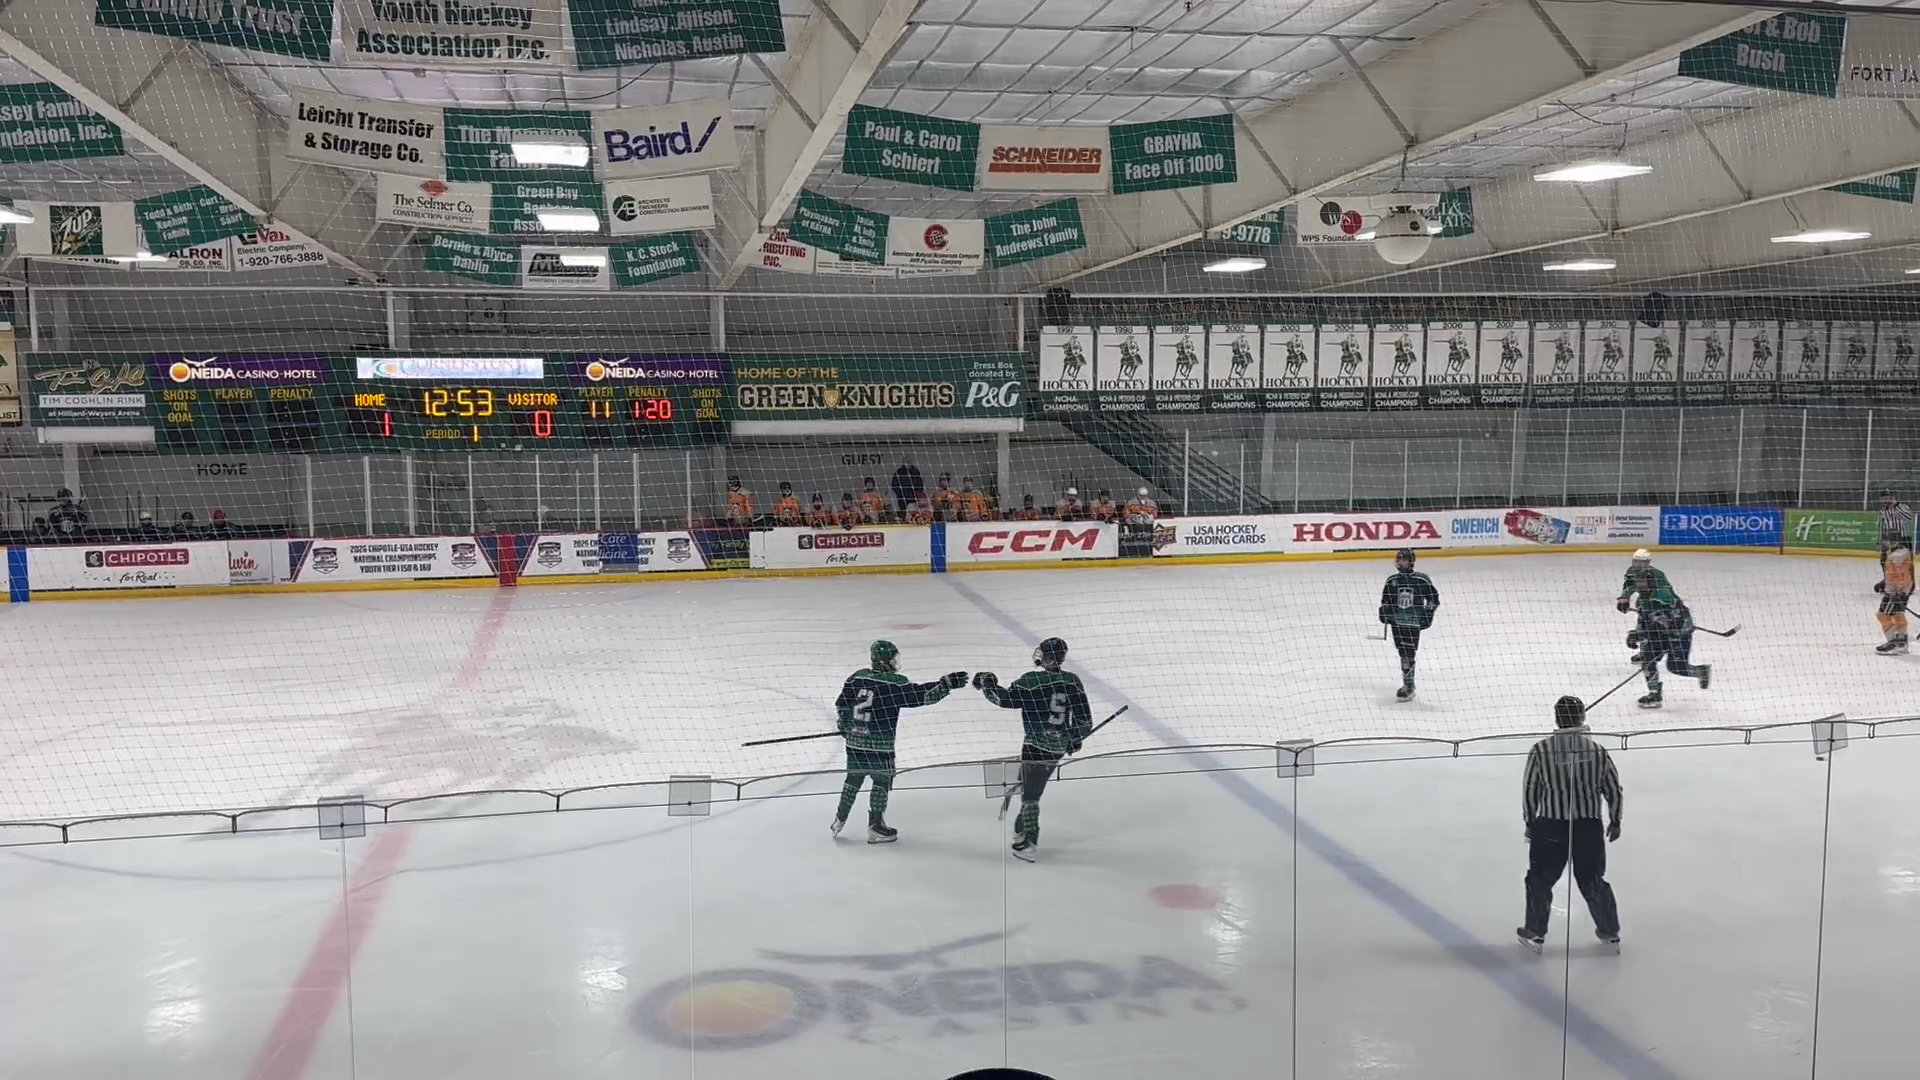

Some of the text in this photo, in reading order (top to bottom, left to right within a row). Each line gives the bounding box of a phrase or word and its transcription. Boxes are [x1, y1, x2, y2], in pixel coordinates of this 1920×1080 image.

[233, 0, 302, 36] Trust
[373, 0, 532, 30] Youth Hockey
[606, 9, 737, 36] Lindsay, Allison,
[1782, 16, 1821, 43] Bob
[507, 35, 550, 60] Inc.
[614, 32, 744, 61] Nicholas, Austin
[1737, 43, 1785, 72] Bush
[1851, 67, 1895, 82] FORT
[298, 103, 434, 138] Leicht Transfer
[78, 124, 113, 141] Inc.
[458, 124, 491, 143] The
[865, 120, 962, 154] Paul & Carol
[305, 132, 424, 163] & Storage Co.
[604, 121, 693, 162] Baird
[1144, 132, 1201, 155] GBAYHA
[992, 146, 1102, 164] SCHNEIDER
[1125, 153, 1225, 182] Face Off 1000
[517, 185, 578, 200] Green Bay
[393, 193, 474, 213] The Selmer Co.
[680, 204, 709, 212] MANAGERS
[166, 208, 173, 216] &
[393, 209, 443, 220] CONSTRUCTION
[444, 214, 473, 224] SERVICES
[1010, 216, 1057, 236] The John
[162, 227, 191, 241] Family
[434, 235, 514, 262] Bernie & Alyce
[995, 227, 1078, 257] Andrews Family
[237, 246, 266, 255] Electric
[626, 241, 679, 262] K. C. Stock
[238, 252, 325, 267] 1-920-766-3888
[453, 255, 489, 273] Dahlin
[763, 255, 782, 267] INC.
[627, 256, 687, 277] Foundation
[586, 362, 646, 381] ONEIDA
[974, 361, 1013, 369] Press Box
[169, 362, 236, 383] ONEIDA
[738, 367, 839, 379] HOME OF THE
[1005, 370, 1019, 378] by:
[1429, 375, 1473, 383] HOCKEY
[1481, 374, 1524, 383] HOCKEY
[1043, 381, 1090, 389] HOCKEY
[1100, 380, 1146, 389] HOCKEY
[1156, 380, 1201, 388] HOCKEY
[1211, 379, 1257, 388] HOCKEY
[1266, 378, 1311, 387] HOCKEY
[1320, 377, 1365, 386] HOCKEY
[1375, 377, 1420, 385] HOCKEY
[163, 390, 197, 400] SHOTS
[215, 389, 253, 399] PLAYER
[270, 388, 314, 398] PENALTY
[579, 388, 613, 396] PLAYER
[629, 388, 668, 397] PENALTY
[693, 389, 722, 397] SHOTS
[737, 383, 955, 410] GREEN KNIGHTS
[965, 381, 1021, 407] P&G
[43, 397, 60, 405] TIM
[65, 397, 113, 405] COGHLIN
[355, 394, 385, 406] HOME
[425, 389, 493, 416] 12:53
[508, 393, 558, 406] VISITOR
[701, 399, 714, 408] ON
[1211, 401, 1256, 409] CHAMPIONS
[173, 402, 188, 411] ON
[592, 400, 609, 418] 11
[1101, 403, 1146, 411] CHAMPIONS
[168, 413, 194, 422] GOAL
[696, 409, 719, 418] GOAL
[384, 412, 391, 437] 1
[535, 411, 551, 437] 0
[426, 429, 460, 439] PERIOD
[473, 425, 479, 443] 1
[842, 454, 884, 466] GUEST
[197, 463, 247, 476] HOME
[1193, 524, 1258, 535] USA HOCKEY
[1292, 520, 1442, 542] HONDA
[1451, 517, 1500, 534] CWENCH
[1691, 515, 1774, 537] ROBINSON
[600, 535, 627, 544] Care
[817, 535, 882, 547] CHIPOTLE
[967, 528, 1100, 556] CCM
[1184, 533, 1266, 546] TRADING CARDS
[414, 543, 439, 551] HOCKEY
[108, 552, 186, 564] CHIPOTLE
[353, 553, 437, 563] NATIONAL CHAMPIONSHIPS
[826, 553, 859, 564] for Real
[360, 565, 382, 573] YOUTH
[119, 571, 157, 583] for Real
[853, 688, 874, 722] 2
[1048, 692, 1069, 725] 5
[628, 955, 1231, 1051] ONEIDA
